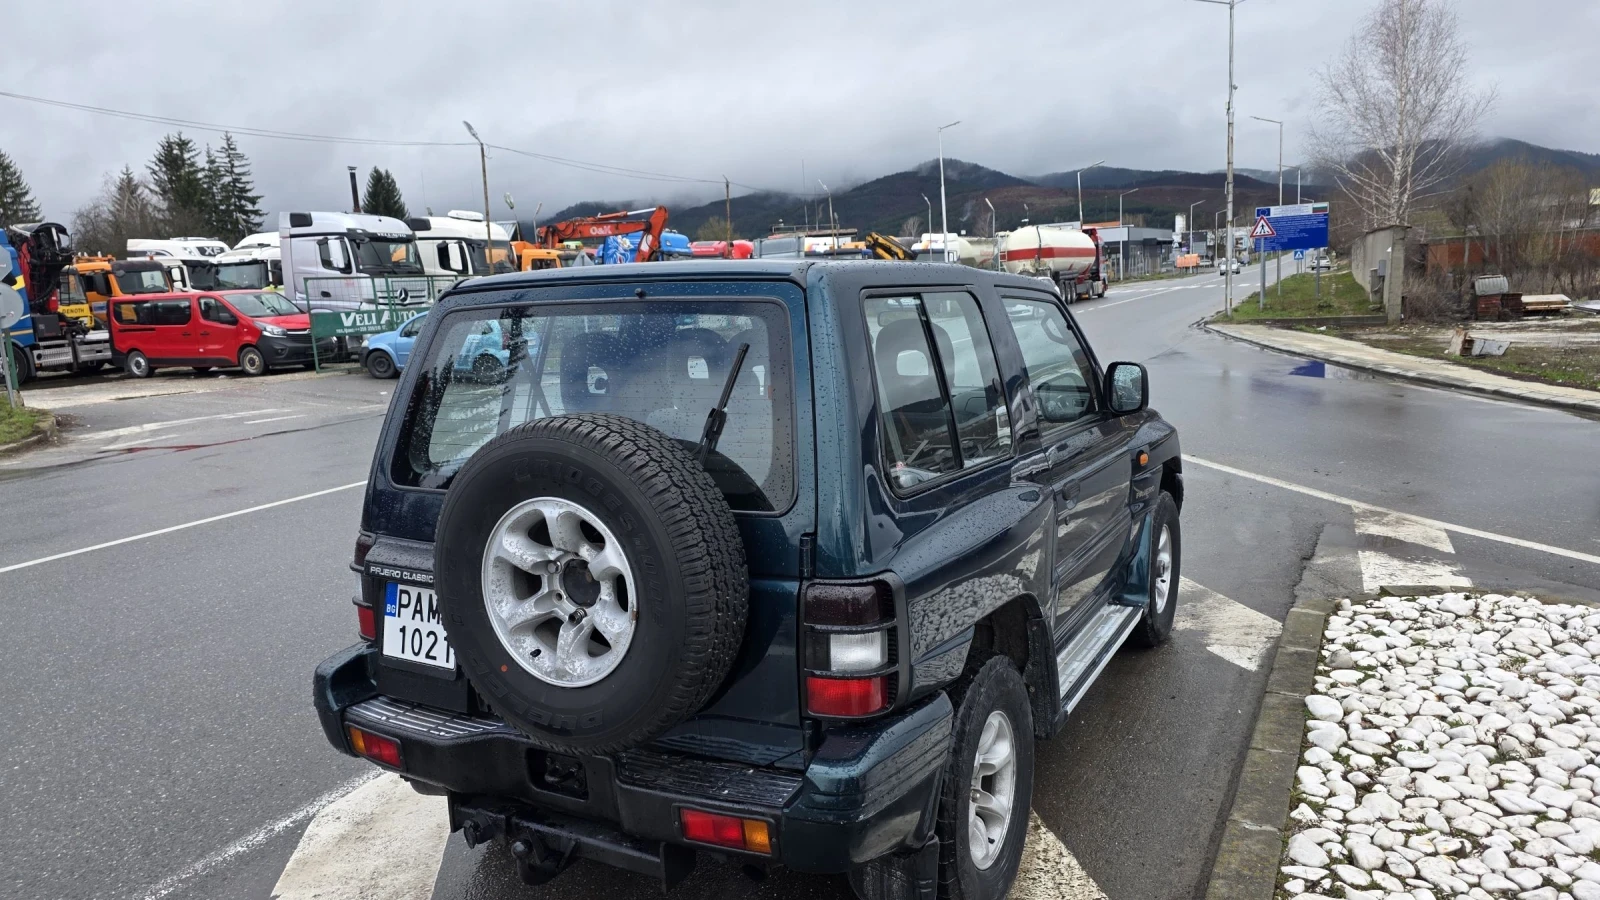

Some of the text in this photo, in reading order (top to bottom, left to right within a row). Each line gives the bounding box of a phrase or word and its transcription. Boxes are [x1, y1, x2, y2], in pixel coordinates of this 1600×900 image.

[590, 225, 612, 235] O&K
[203, 246, 221, 256] XF
[340, 312, 377, 327] VELI
[370, 566, 434, 583] PAJERO CLASSIC
[386, 603, 396, 613] BG
[397, 588, 441, 625] PAM
[399, 625, 450, 663] 1021
